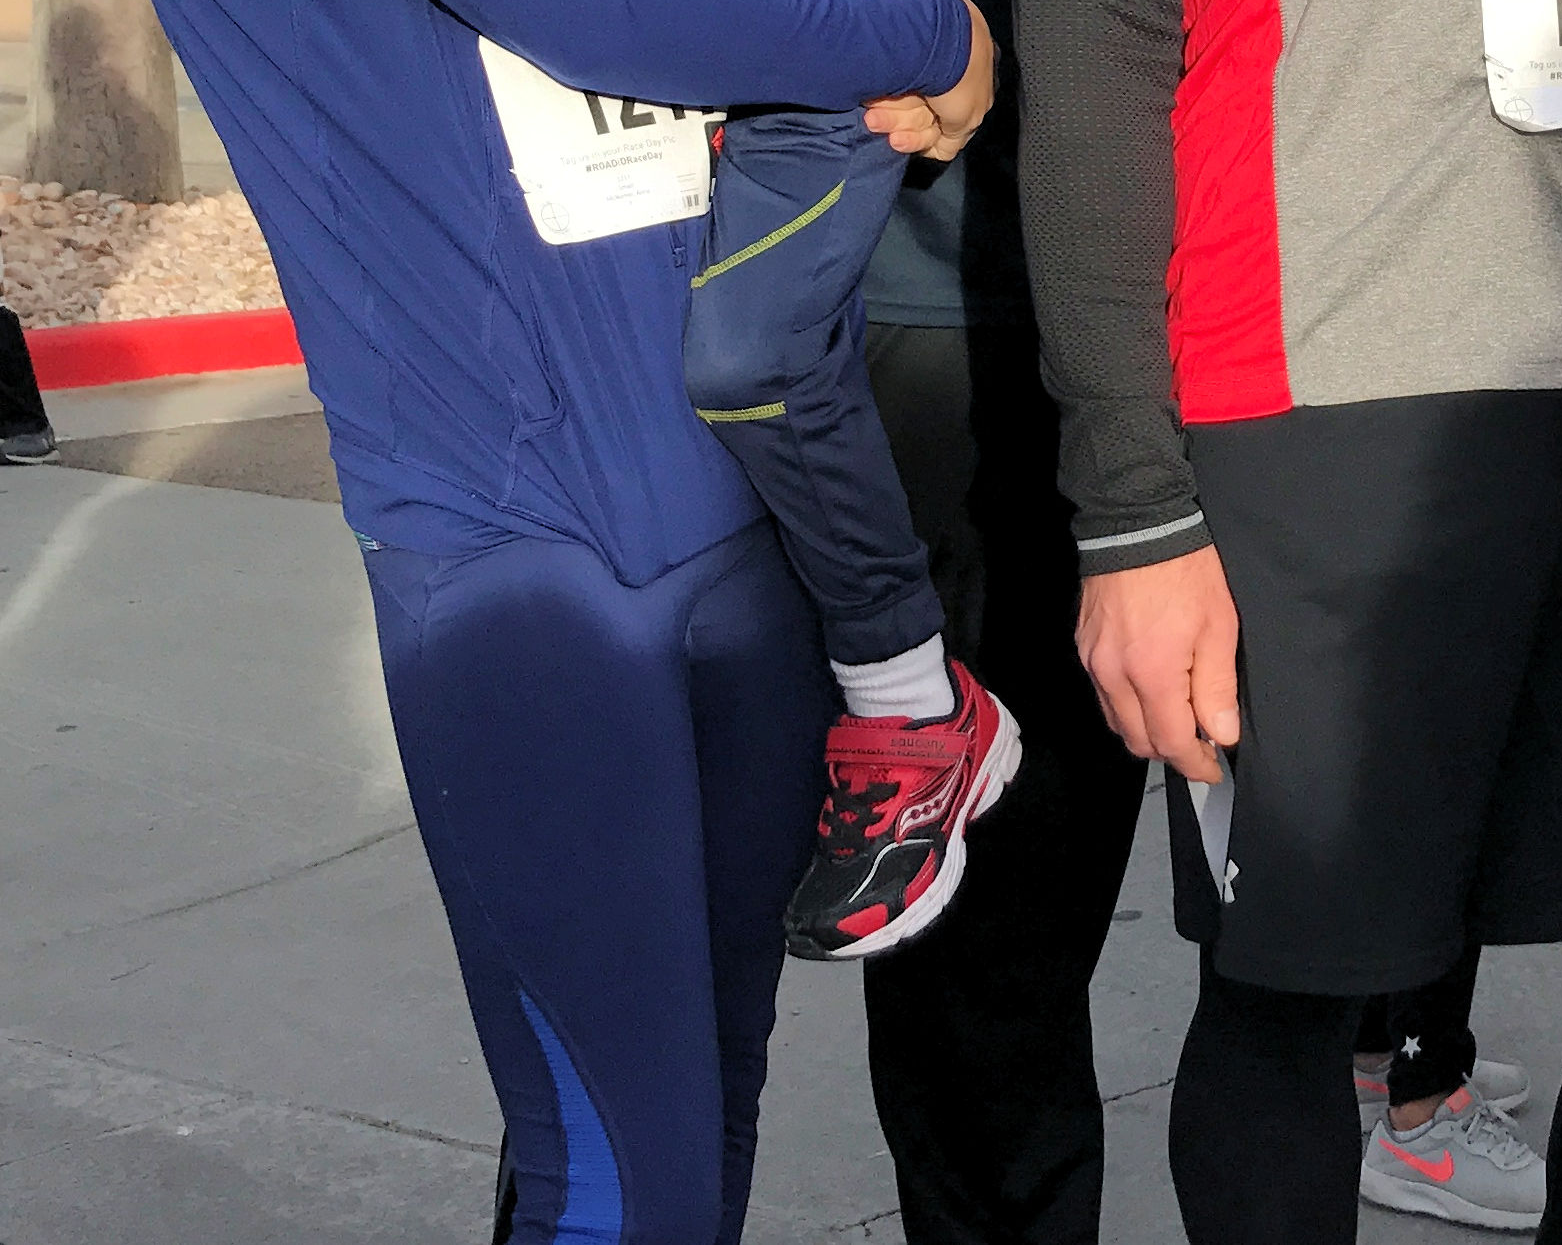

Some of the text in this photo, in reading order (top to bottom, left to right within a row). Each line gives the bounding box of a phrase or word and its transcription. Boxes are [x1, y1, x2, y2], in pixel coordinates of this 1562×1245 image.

[1529, 60, 1544, 70] Tag
[1546, 61, 1557, 69] us
[646, 138, 662, 148] Day
